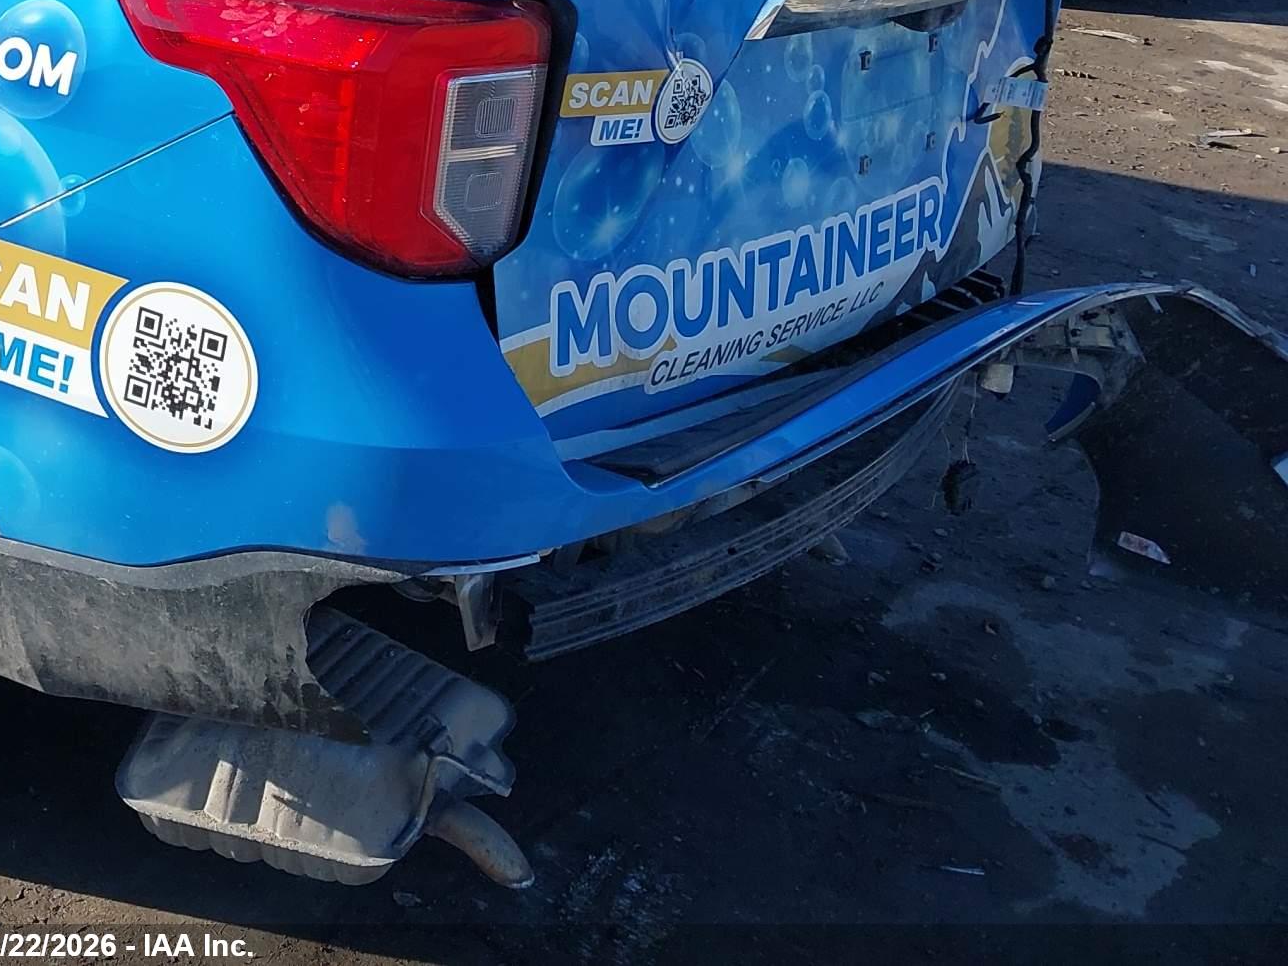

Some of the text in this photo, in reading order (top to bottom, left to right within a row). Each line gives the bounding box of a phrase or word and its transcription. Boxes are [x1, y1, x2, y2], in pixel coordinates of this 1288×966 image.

[569, 79, 654, 109] SCAN
[599, 118, 643, 142] ME!
[557, 191, 945, 367] MOUNTAINEER
[650, 331, 762, 386] CLEANING
[847, 282, 885, 320] LLC
